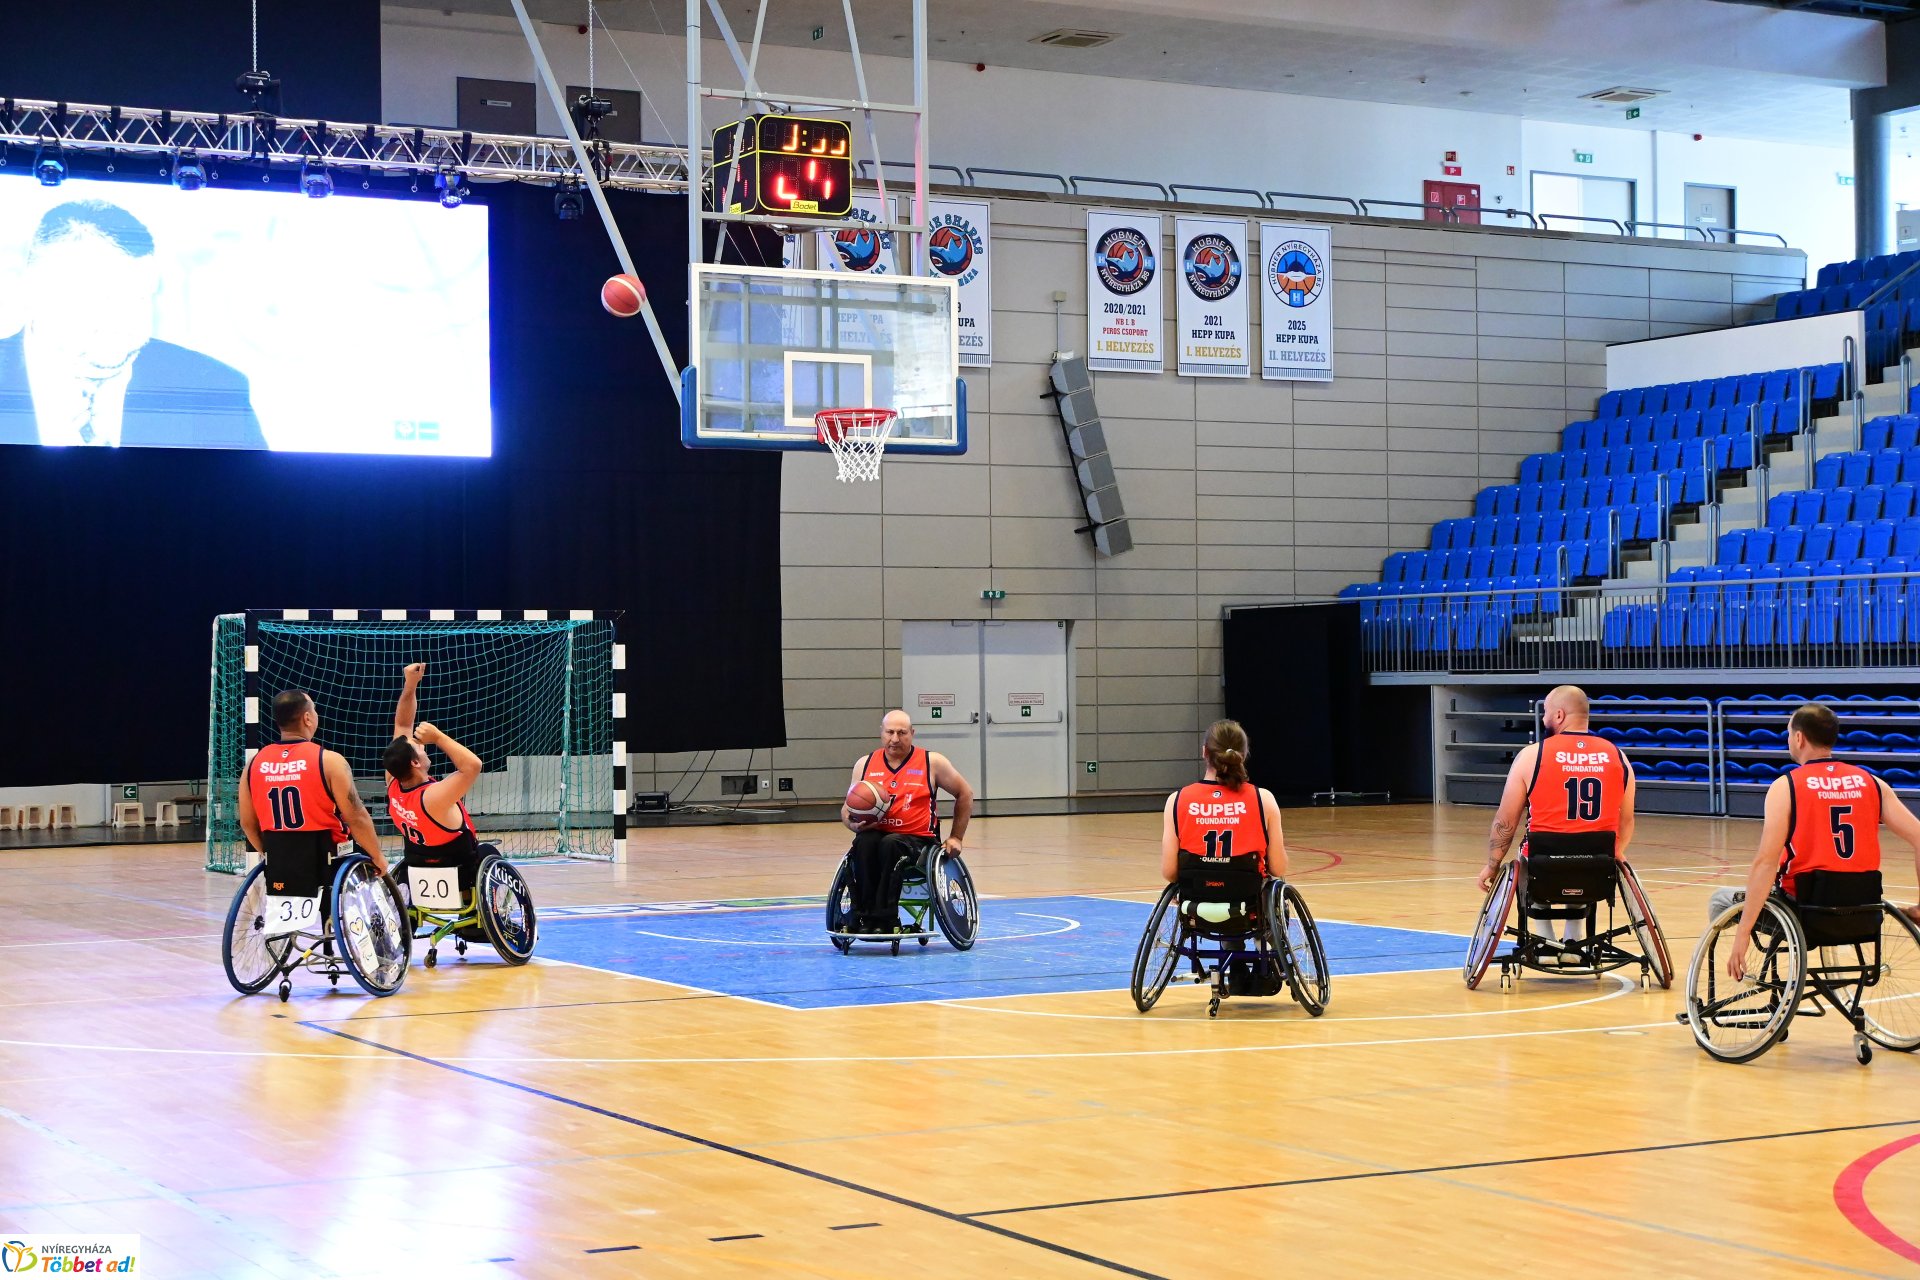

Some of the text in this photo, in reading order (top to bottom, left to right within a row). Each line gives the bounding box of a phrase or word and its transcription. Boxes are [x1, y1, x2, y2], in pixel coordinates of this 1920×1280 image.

[793, 202, 816, 210] Bodet
[1105, 231, 1146, 248] HÜBNER
[1104, 303, 1146, 315] 2020/2021
[958, 318, 975, 327] UPA
[1204, 315, 1222, 326] 2021
[1288, 320, 1306, 331] 2025
[1121, 328, 1148, 336] CSOPORT
[1192, 329, 1235, 340] HEPP KUPA
[1276, 334, 1319, 344] HEPP KUPA
[1106, 340, 1154, 353] HELYEZÉS
[1195, 345, 1241, 358] HELYEZÉS
[1269, 349, 1326, 363] II. HELYEZÉS
[1555, 752, 1609, 764] SUPER
[260, 760, 307, 774] SUPER
[1806, 775, 1866, 790] SUPER
[1564, 777, 1602, 821] 19
[268, 786, 305, 830] 10
[1188, 802, 1246, 816] SUPER
[1829, 805, 1854, 860] 5
[1203, 829, 1232, 857] 11
[418, 879, 448, 898] 2.0
[280, 898, 313, 922] 3.0
